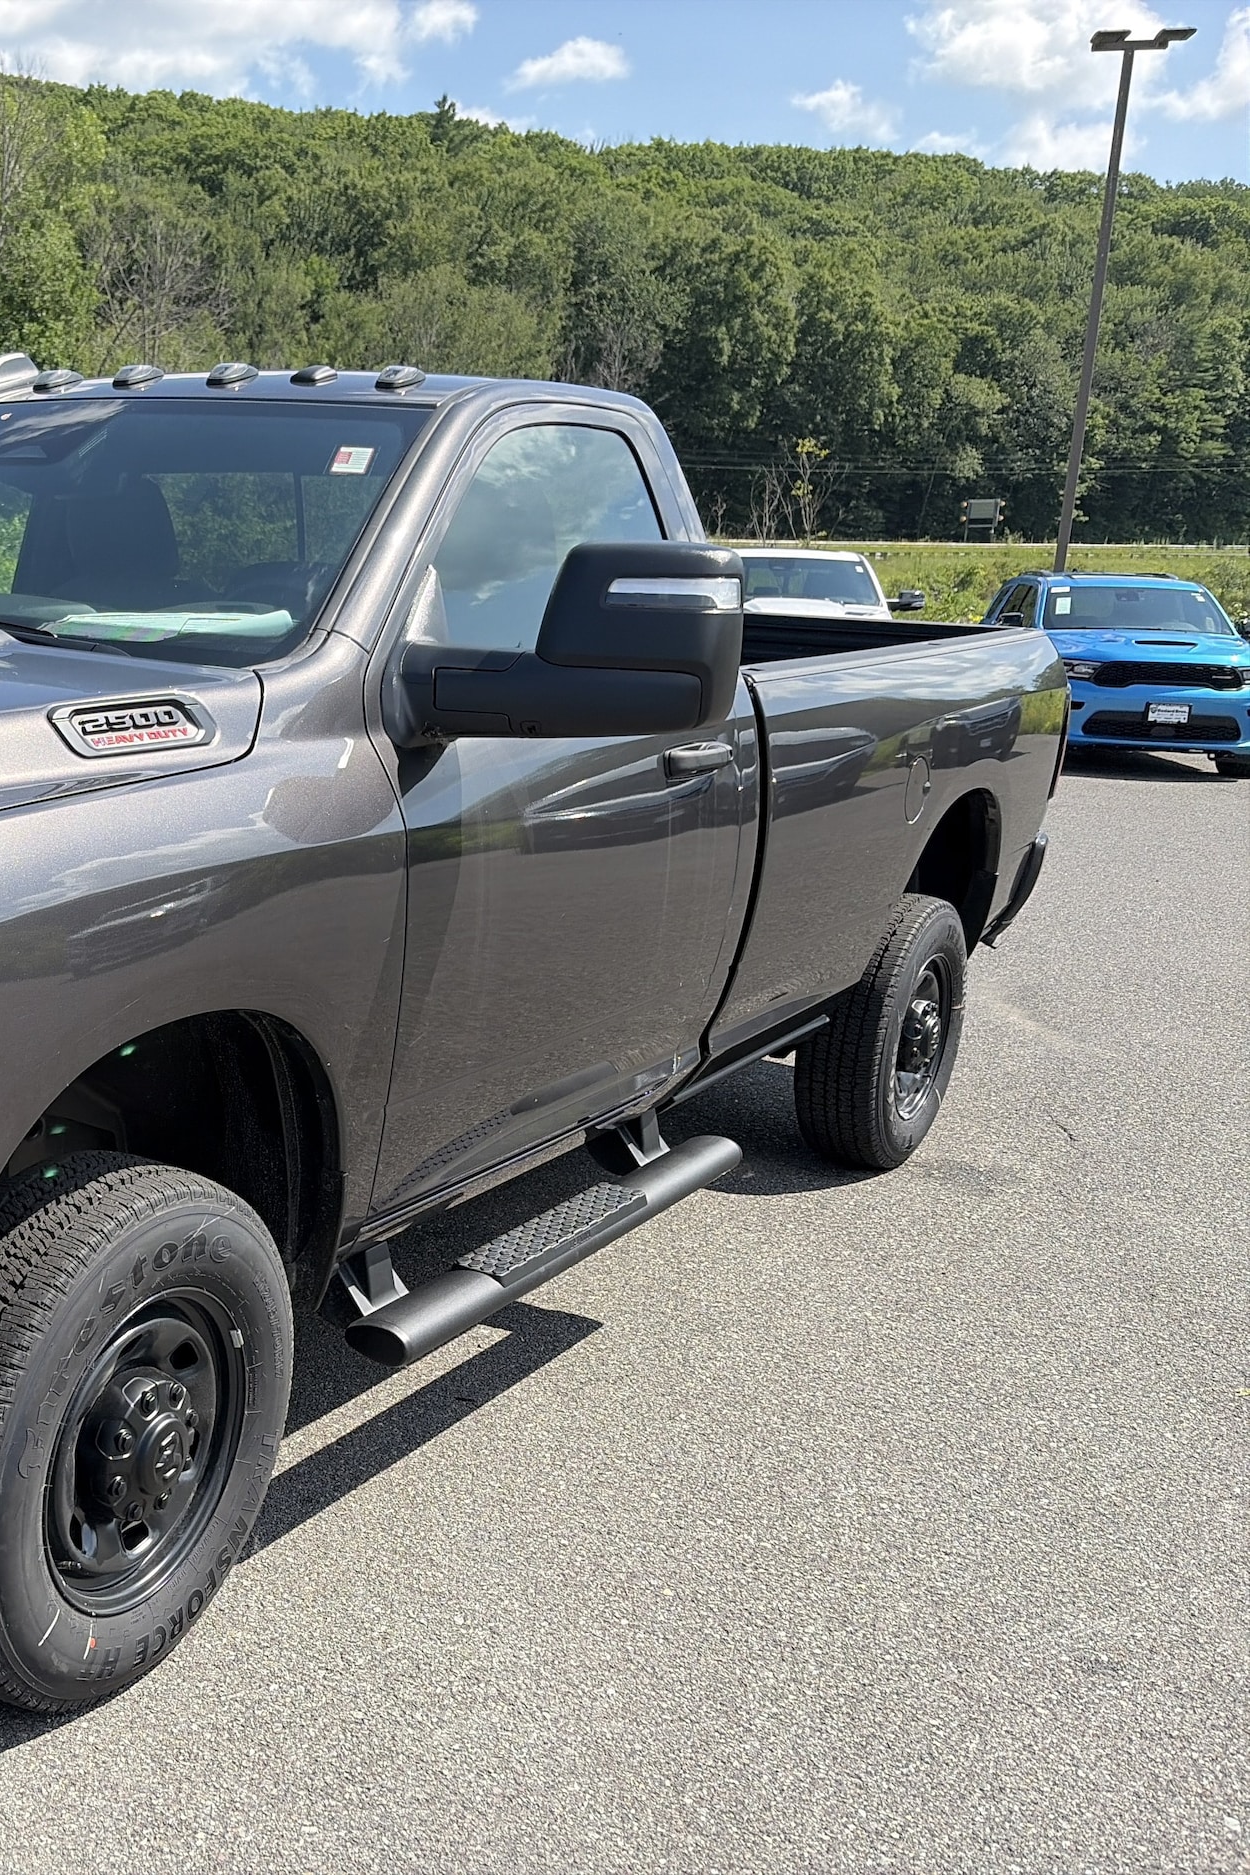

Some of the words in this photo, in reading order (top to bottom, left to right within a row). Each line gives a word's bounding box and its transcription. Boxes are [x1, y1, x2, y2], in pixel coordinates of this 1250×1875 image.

[78, 708, 181, 737] 2500
[90, 732, 145, 748] HEAVY
[147, 727, 188, 741] DUTY
[17, 1230, 232, 1479] Firestone
[132, 1429, 281, 1671] TRANSFORCE
